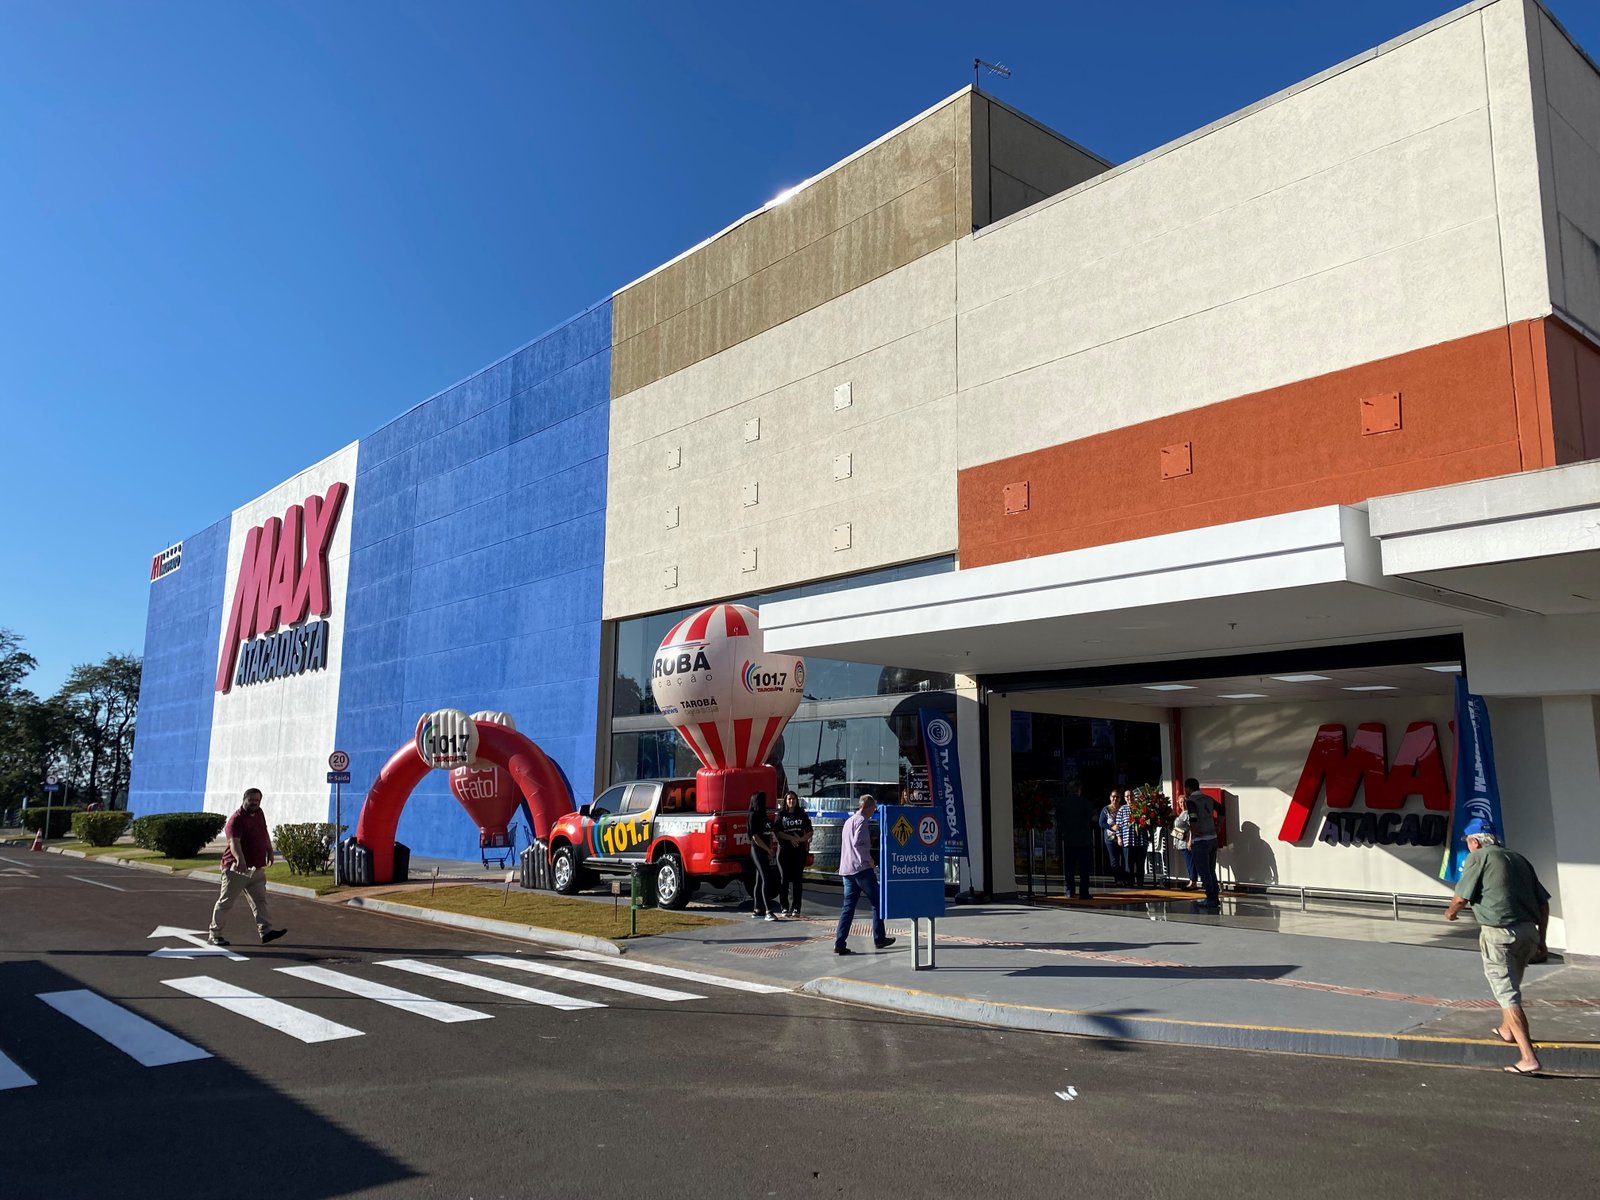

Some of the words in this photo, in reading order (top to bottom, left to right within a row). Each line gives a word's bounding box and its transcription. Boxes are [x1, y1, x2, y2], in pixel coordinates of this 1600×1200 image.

[215, 482, 349, 694] MAX
[235, 620, 329, 688] ATACADISTA
[652, 646, 711, 678] ROBÁ
[658, 674, 713, 688] cação
[753, 672, 787, 687] 101.7
[428, 734, 470, 755] 101.7
[333, 755, 346, 764] 20
[939, 748, 949, 771] TV
[1278, 721, 1455, 843] MA
[603, 809, 654, 856] 101.7
[922, 821, 936, 834] 20
[1319, 812, 1449, 847] ATACAD
[891, 852, 928, 862] Travessia
[929, 851, 940, 862] de
[892, 864, 930, 875] Pedestres
